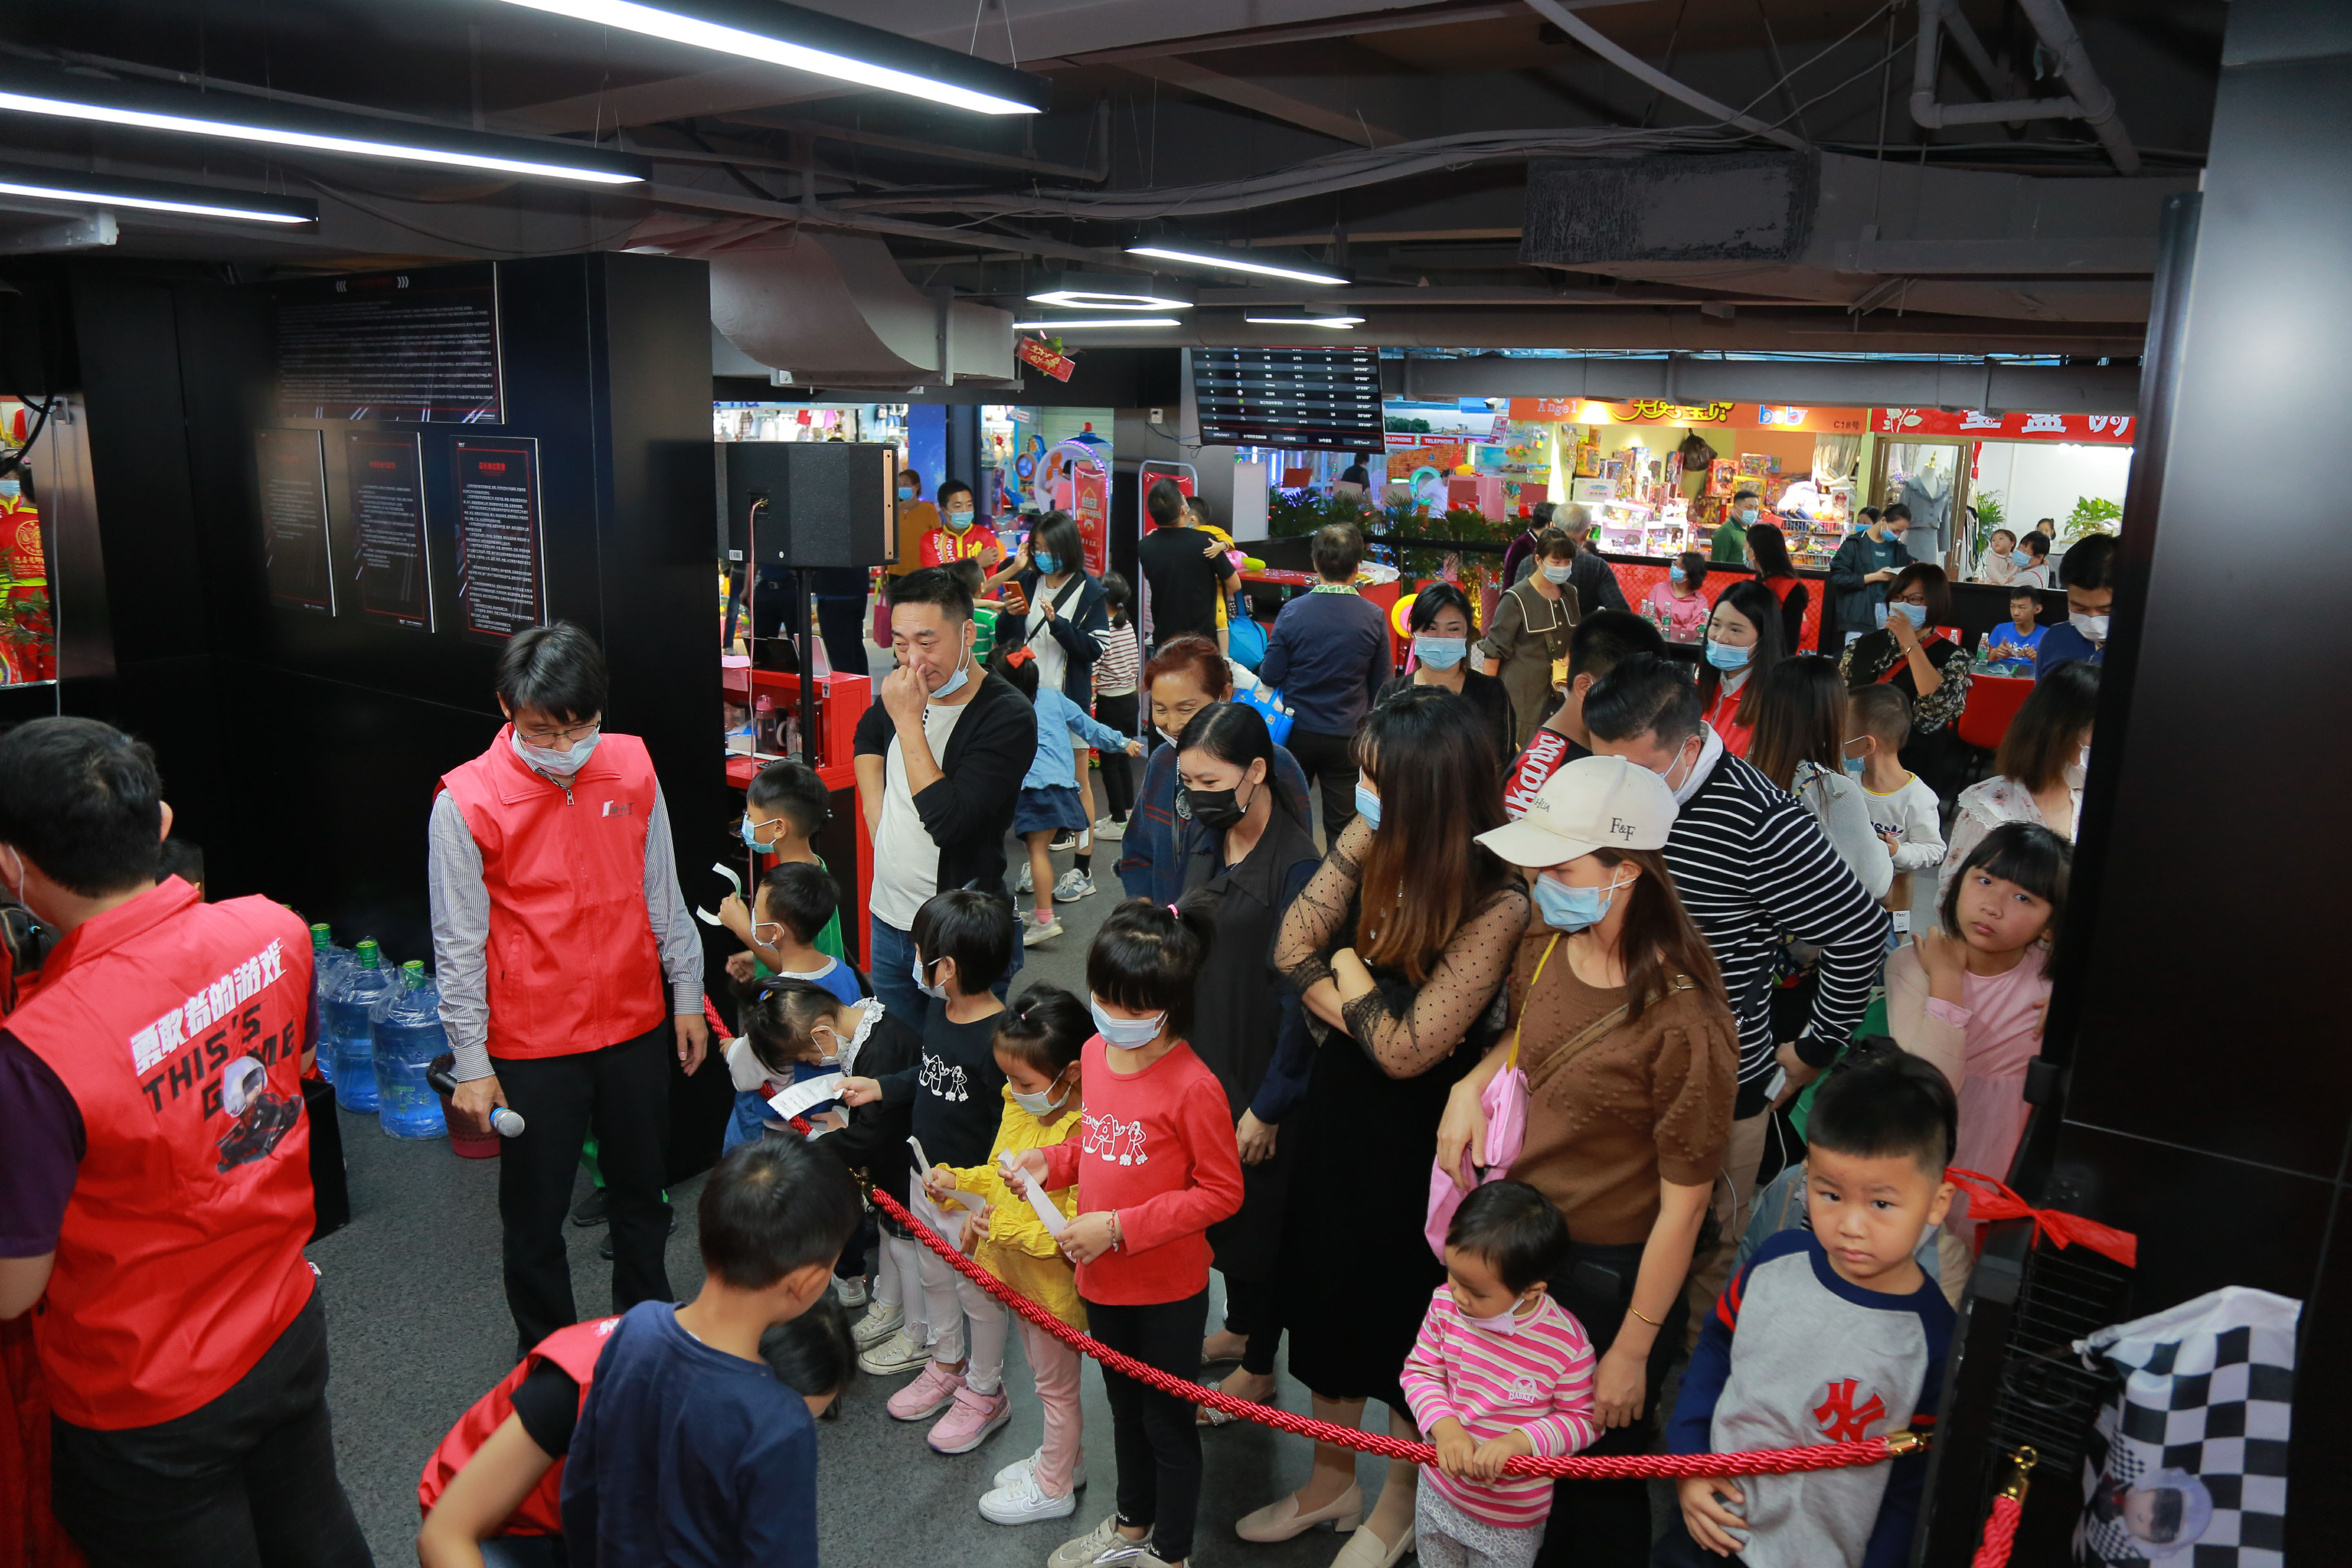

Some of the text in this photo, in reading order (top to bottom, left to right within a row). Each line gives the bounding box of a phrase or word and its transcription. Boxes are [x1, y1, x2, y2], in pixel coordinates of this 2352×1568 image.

[1537, 400, 1577, 416] Angel
[1833, 421, 1860, 430] C18号
[1610, 817, 1636, 841] F&F
[131, 937, 287, 1077] 勇敢者的游戏
[143, 1000, 267, 1113] THIS'S
[202, 1015, 298, 1122] GME
